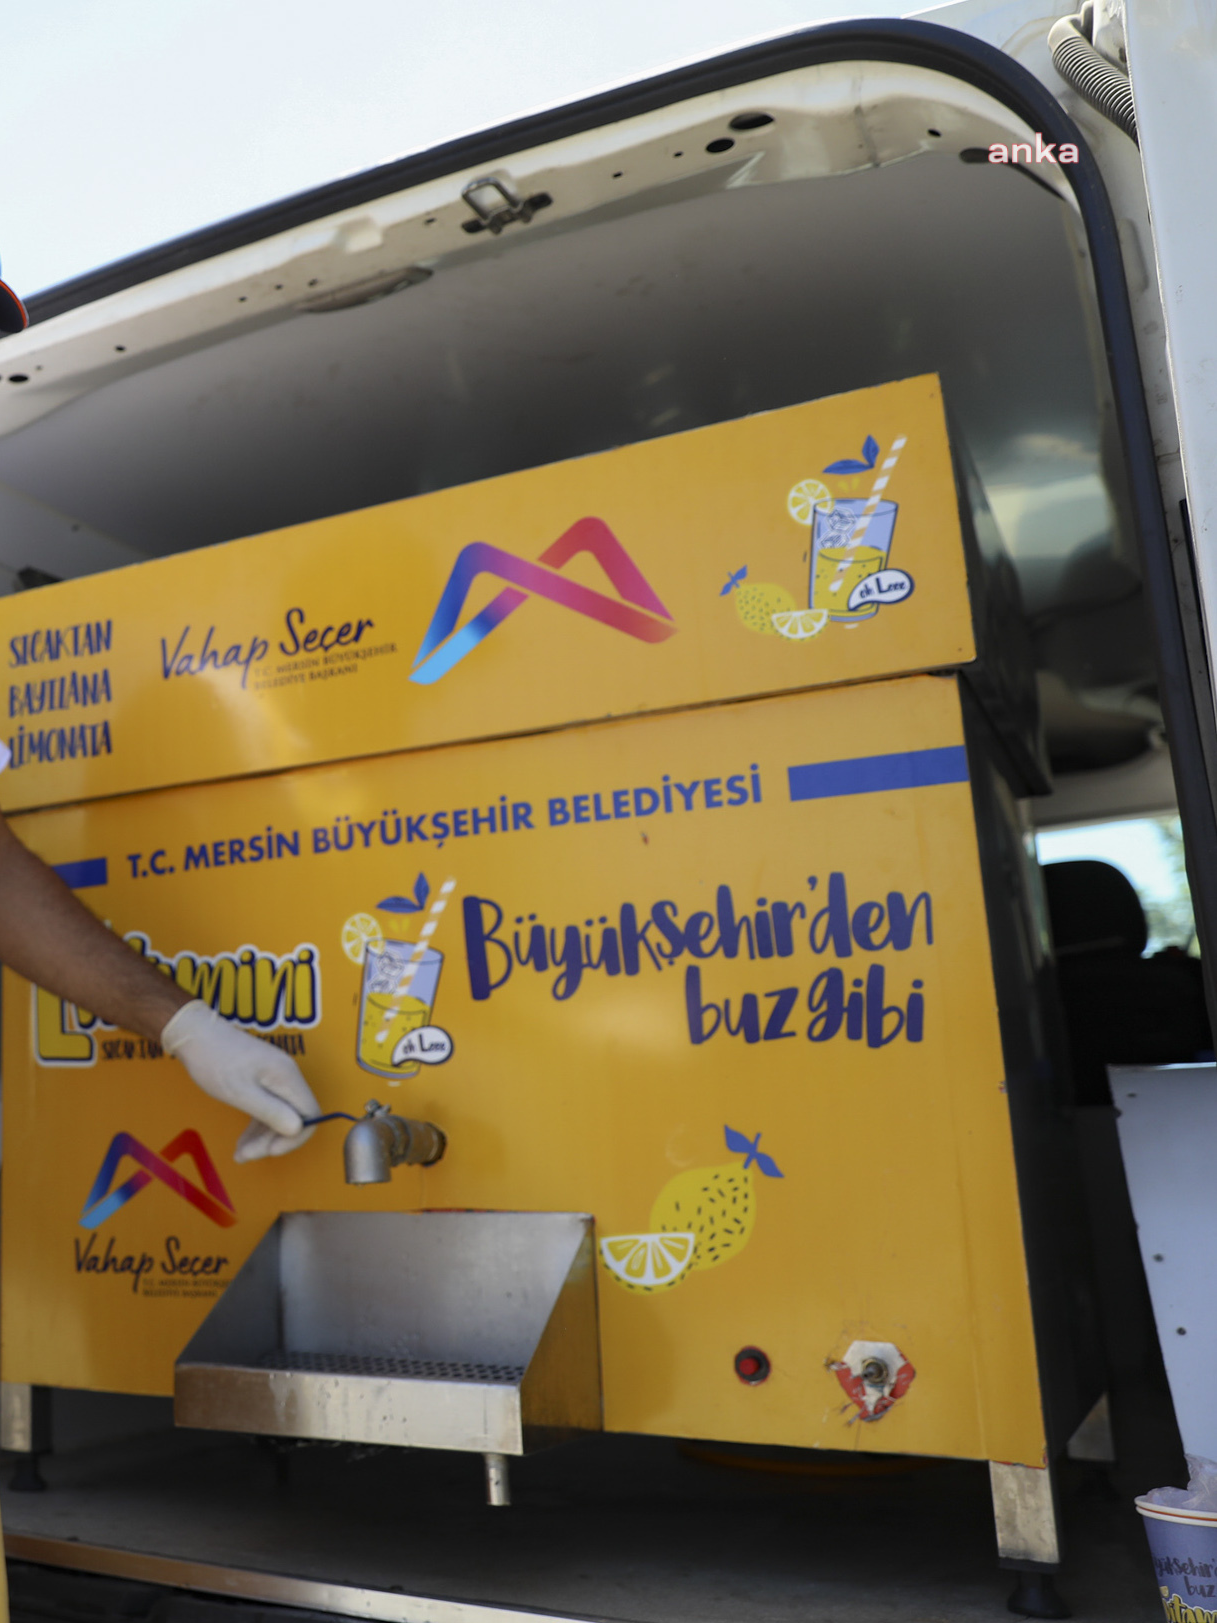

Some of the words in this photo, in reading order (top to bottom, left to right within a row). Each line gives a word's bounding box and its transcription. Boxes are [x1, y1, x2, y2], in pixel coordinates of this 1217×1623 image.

[9, 619, 112, 668] SICAKTAN
[160, 625, 269, 690] Vahap
[279, 607, 374, 656] Seçer
[9, 720, 112, 769] LİMONATA
[127, 850, 175, 880] T.C.
[183, 825, 300, 871] MERSİN
[312, 795, 535, 855] BÜYÜKŞEHİR
[547, 763, 764, 828] BELEDİYESİ
[462, 871, 934, 1002] Büyükşehir'den
[685, 964, 800, 1046] buz
[806, 963, 924, 1049] gibi
[74, 1232, 154, 1294] Vahap
[161, 1235, 229, 1276] Seçer
[1184, 1575, 1216, 1598] buz
